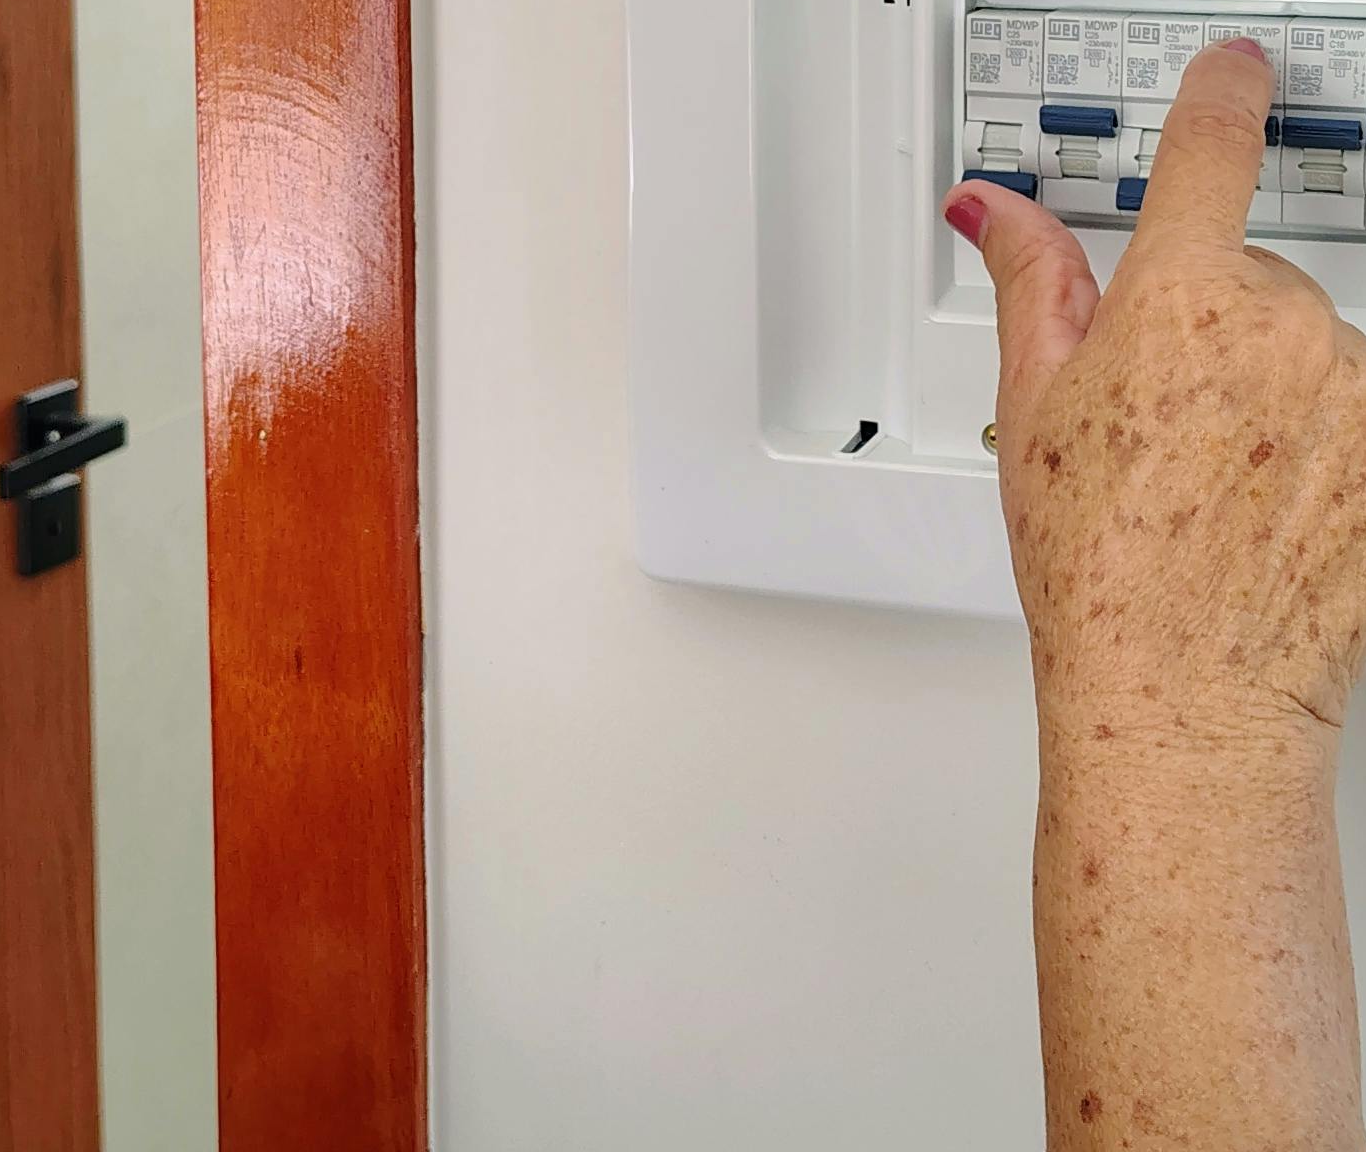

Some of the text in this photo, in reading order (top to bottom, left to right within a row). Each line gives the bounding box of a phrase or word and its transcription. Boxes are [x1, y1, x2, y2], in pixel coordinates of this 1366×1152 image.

[1006, 20, 1039, 30] MDWP
[1085, 21, 1118, 31] MDWP
[1165, 23, 1199, 35] MDWP
[1246, 26, 1280, 37] MDWP
[1330, 29, 1364, 40] MDWP
